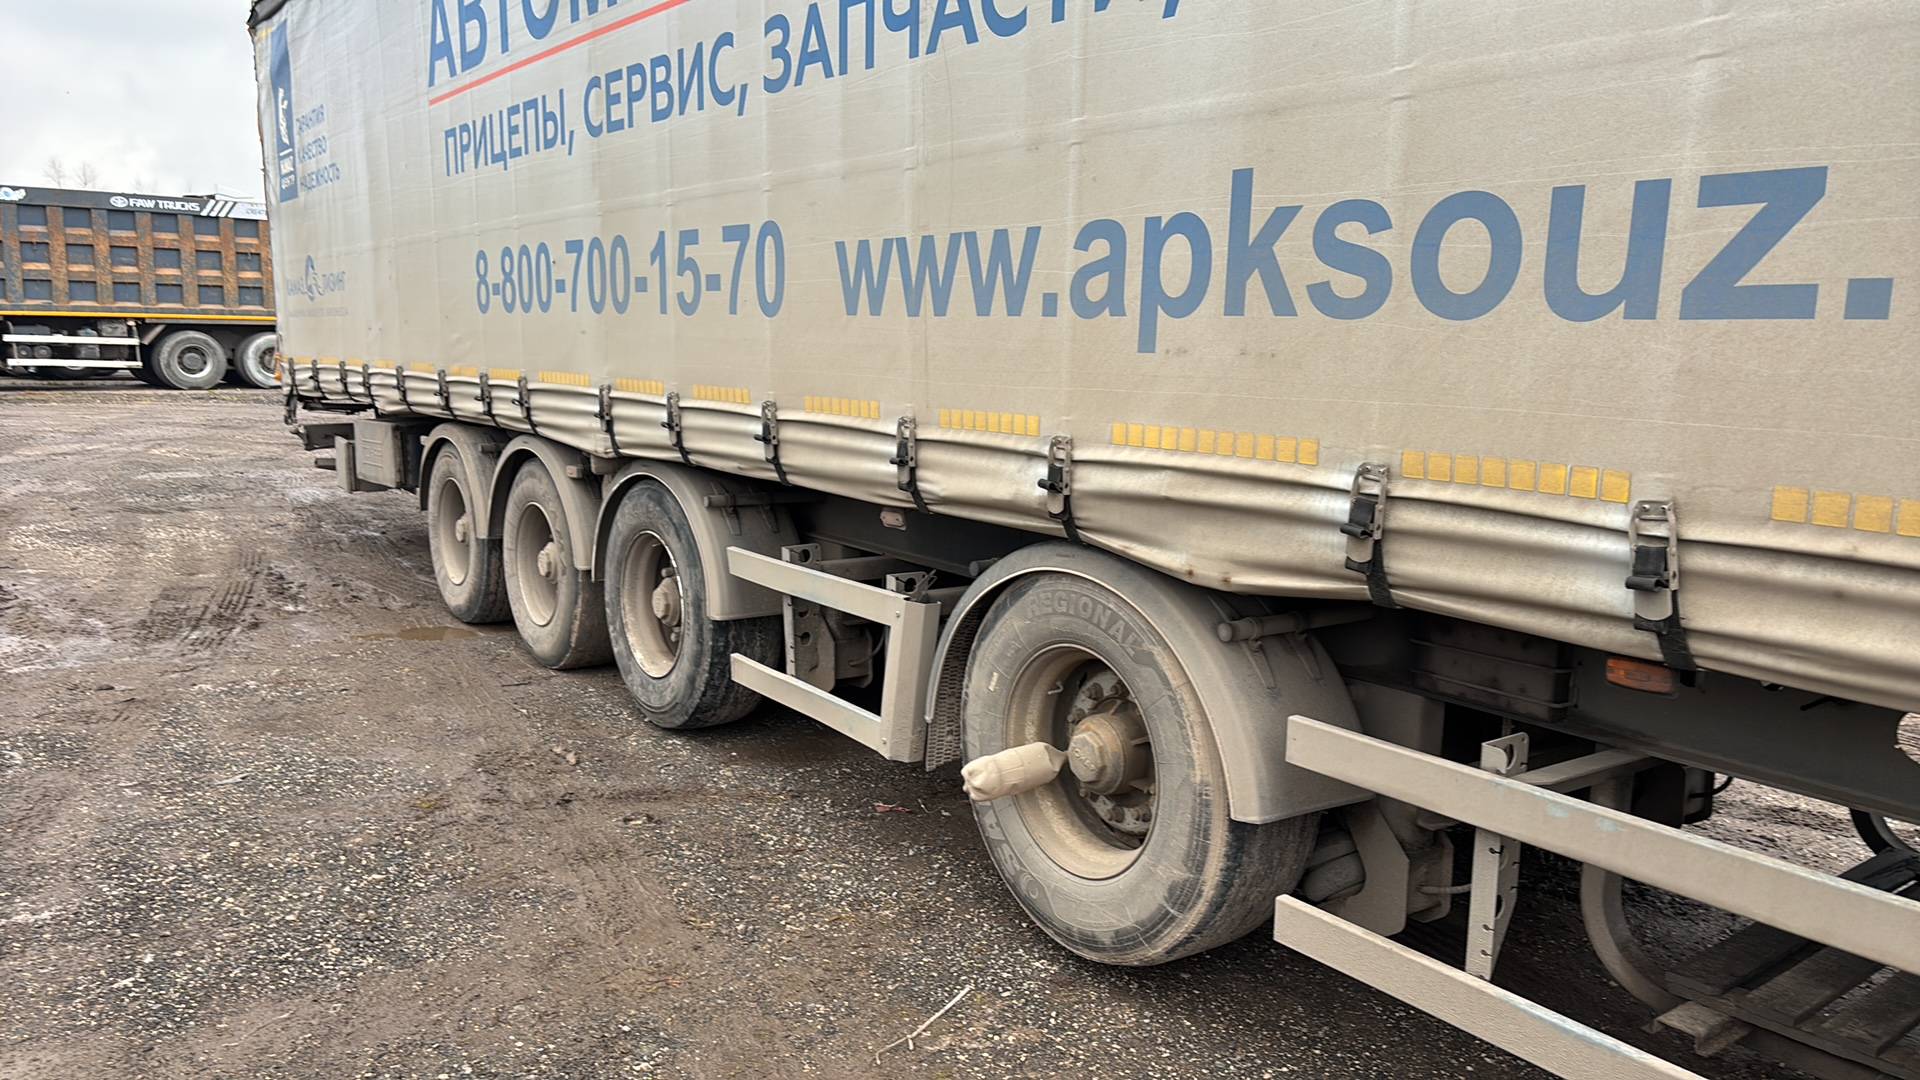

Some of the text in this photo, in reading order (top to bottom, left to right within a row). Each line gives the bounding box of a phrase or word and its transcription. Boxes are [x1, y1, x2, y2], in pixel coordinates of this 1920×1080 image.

[428, 0, 618, 88] АВТО
[444, 0, 1180, 176] ПРИЦЕПЫ, СЕРВИС, ЗАПЧА,
[129, 198, 200, 211] FAW TRUCKS
[475, 167, 1894, 353] 8-800-700-15-70 www.apksouz.
